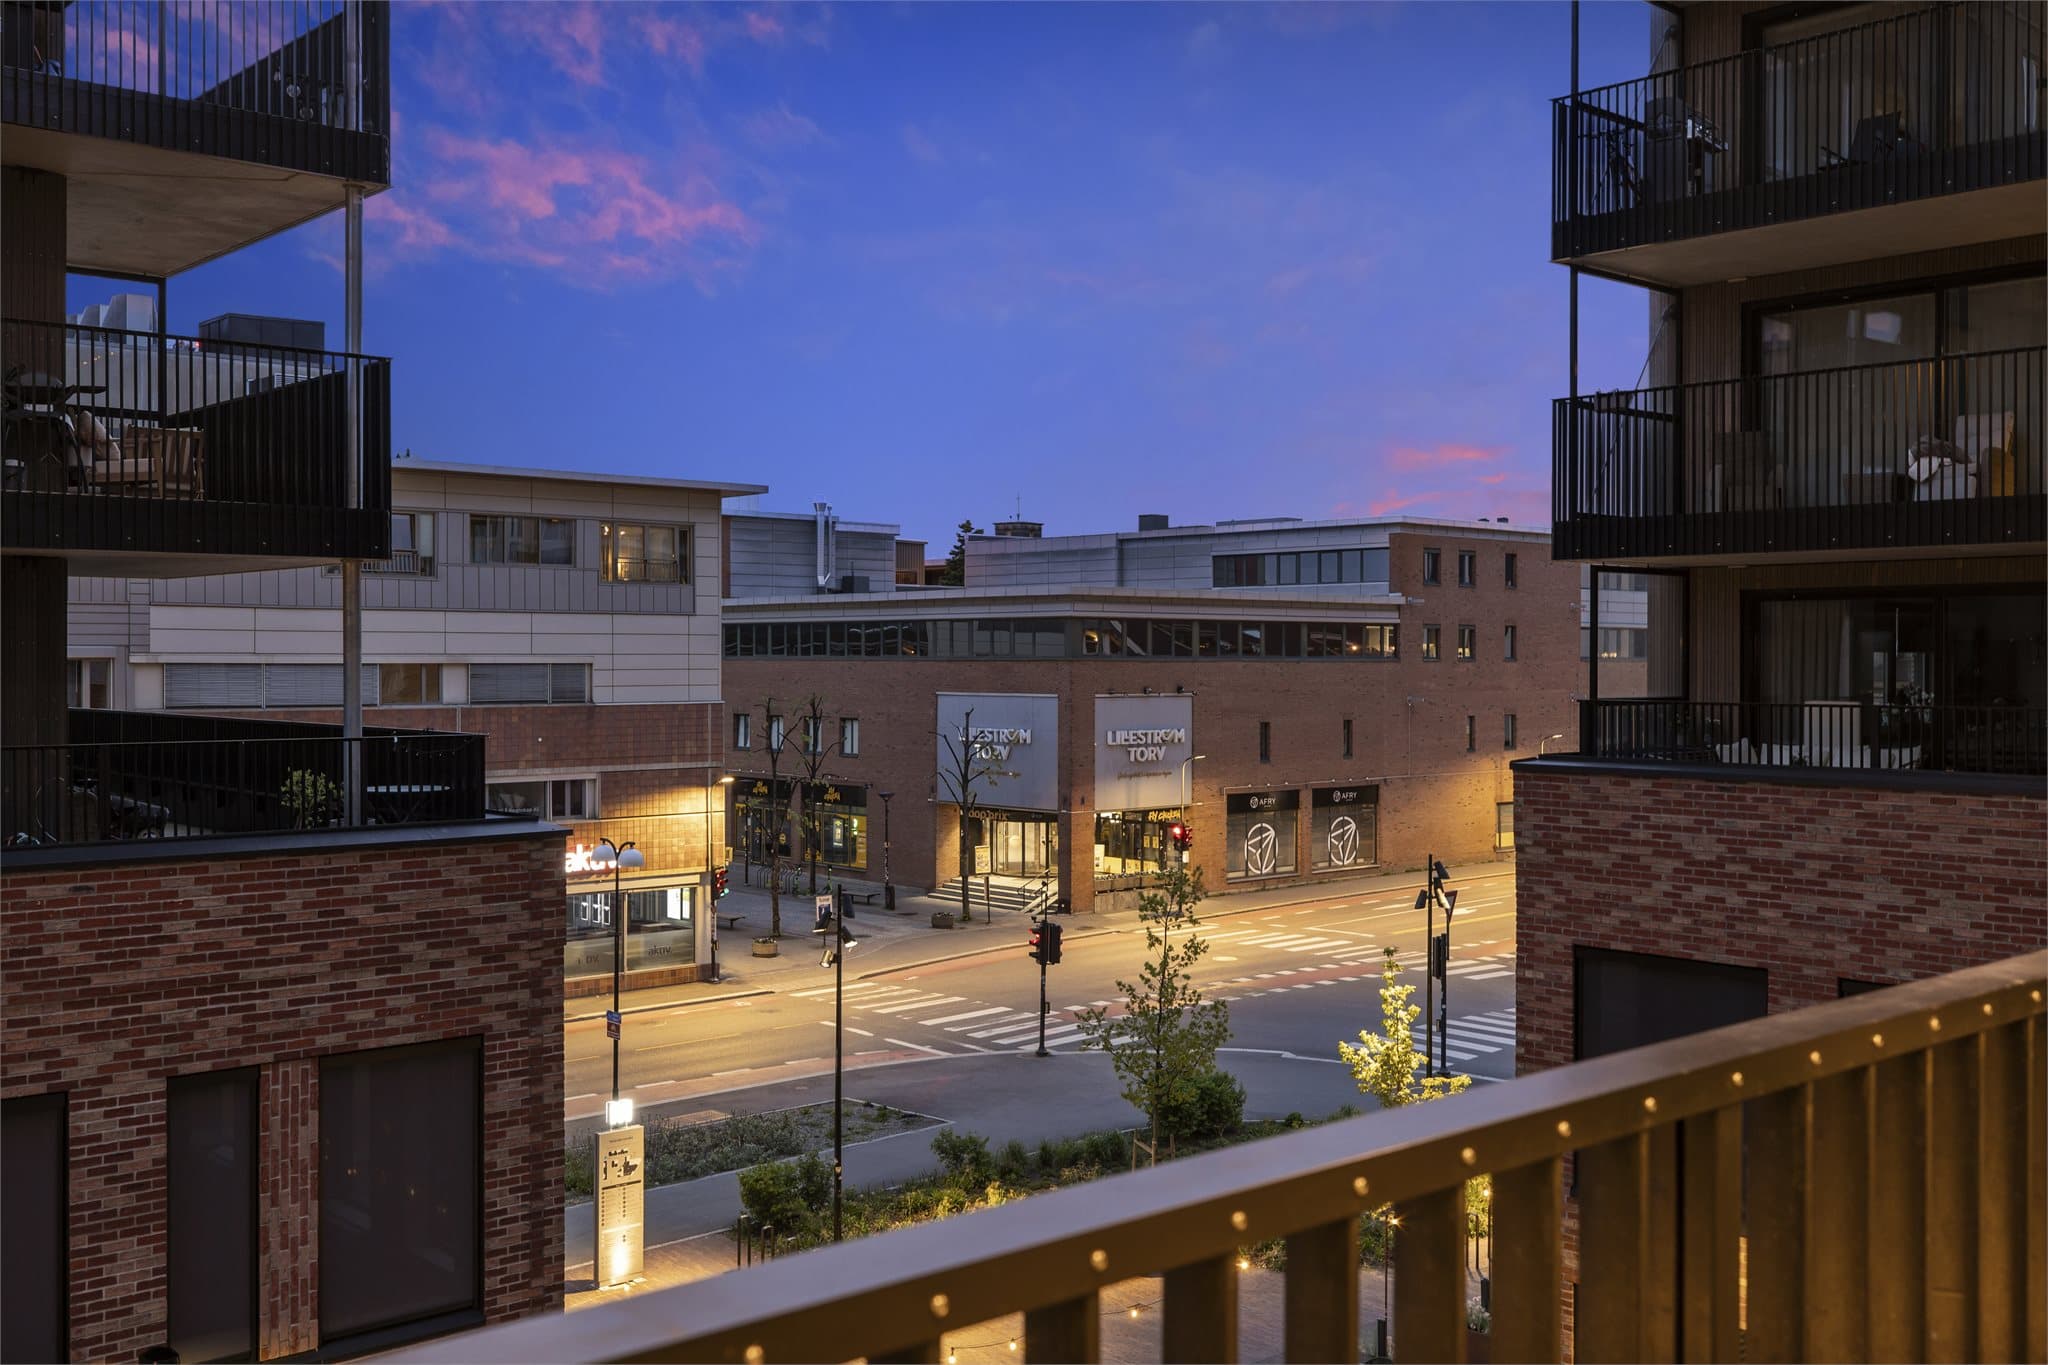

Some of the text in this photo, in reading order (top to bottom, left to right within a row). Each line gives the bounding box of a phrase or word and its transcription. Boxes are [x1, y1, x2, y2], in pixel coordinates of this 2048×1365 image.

[1127, 746, 1167, 762] TORV
[1341, 791, 1358, 799] AFRY
[1259, 798, 1276, 806] AFRY
